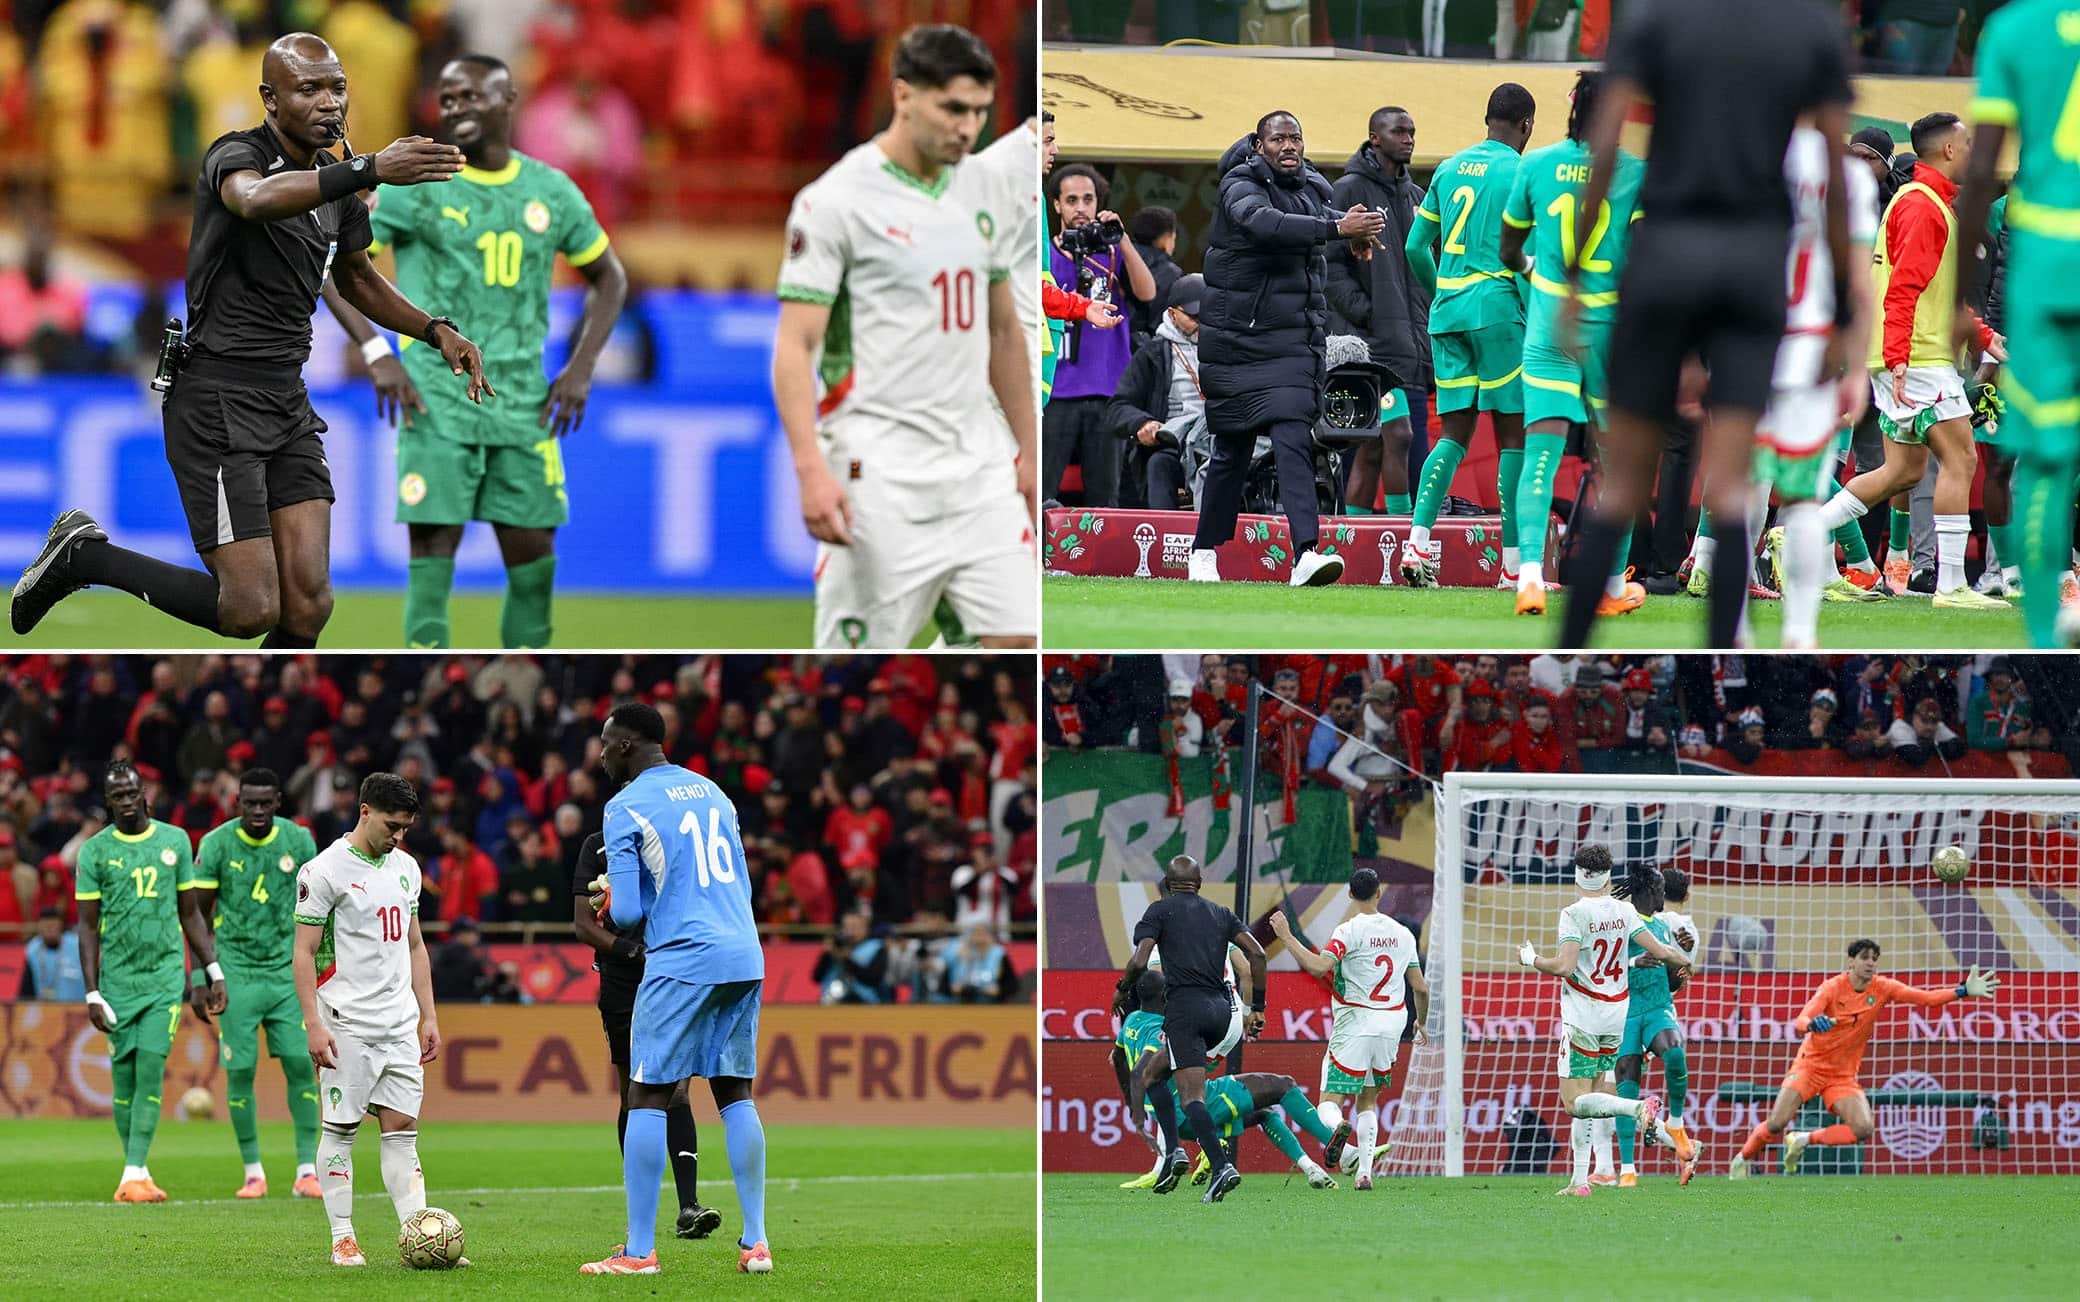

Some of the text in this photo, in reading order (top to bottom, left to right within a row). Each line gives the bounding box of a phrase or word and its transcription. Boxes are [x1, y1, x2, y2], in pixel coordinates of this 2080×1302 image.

[1457, 161, 1488, 177] SARR
[1443, 185, 1475, 255] 2
[1546, 192, 1612, 273] 12
[475, 230, 523, 287] 10
[931, 268, 976, 335] 10
[1162, 554, 1174, 562] OF
[1164, 536, 1191, 545] CAF
[665, 783, 713, 802] MENDY
[679, 807, 736, 888] 16
[131, 866, 158, 898] 12
[251, 874, 269, 904] 4
[376, 905, 402, 942] 10
[1369, 937, 1399, 949] HAKIMI
[1369, 954, 1394, 1002] 2
[1590, 937, 1623, 985] 24
[443, 1031, 1037, 1102] CA AFRICA
